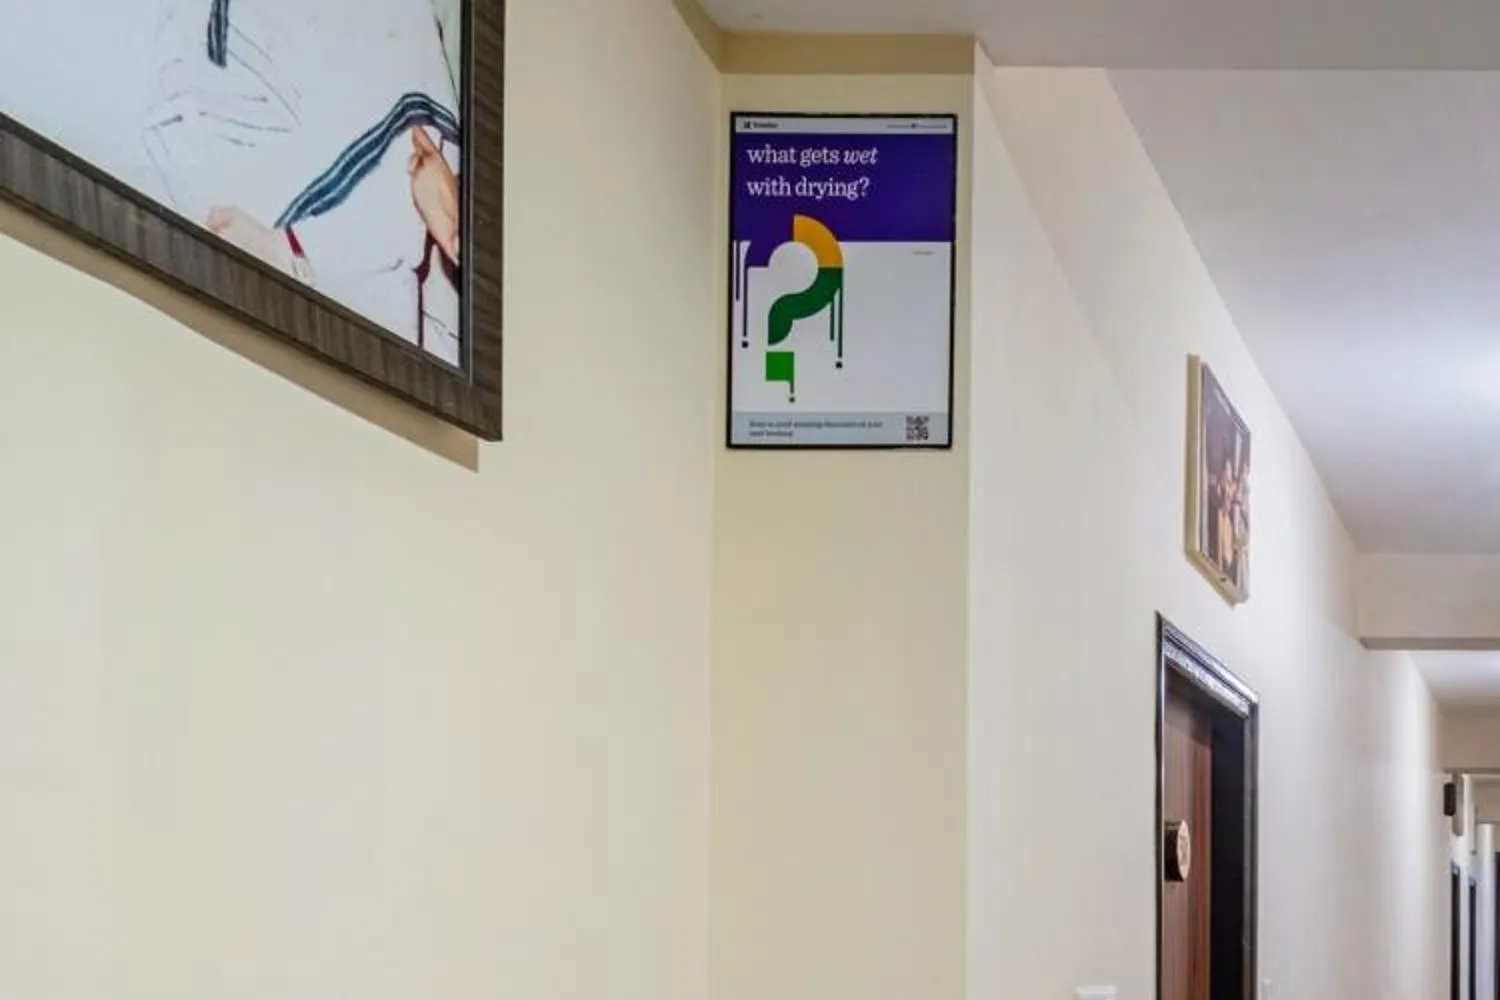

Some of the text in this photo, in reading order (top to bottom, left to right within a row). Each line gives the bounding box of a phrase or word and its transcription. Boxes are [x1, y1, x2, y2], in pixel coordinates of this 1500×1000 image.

[746, 143, 878, 167] what gets wet
[746, 176, 870, 200] with drying?
